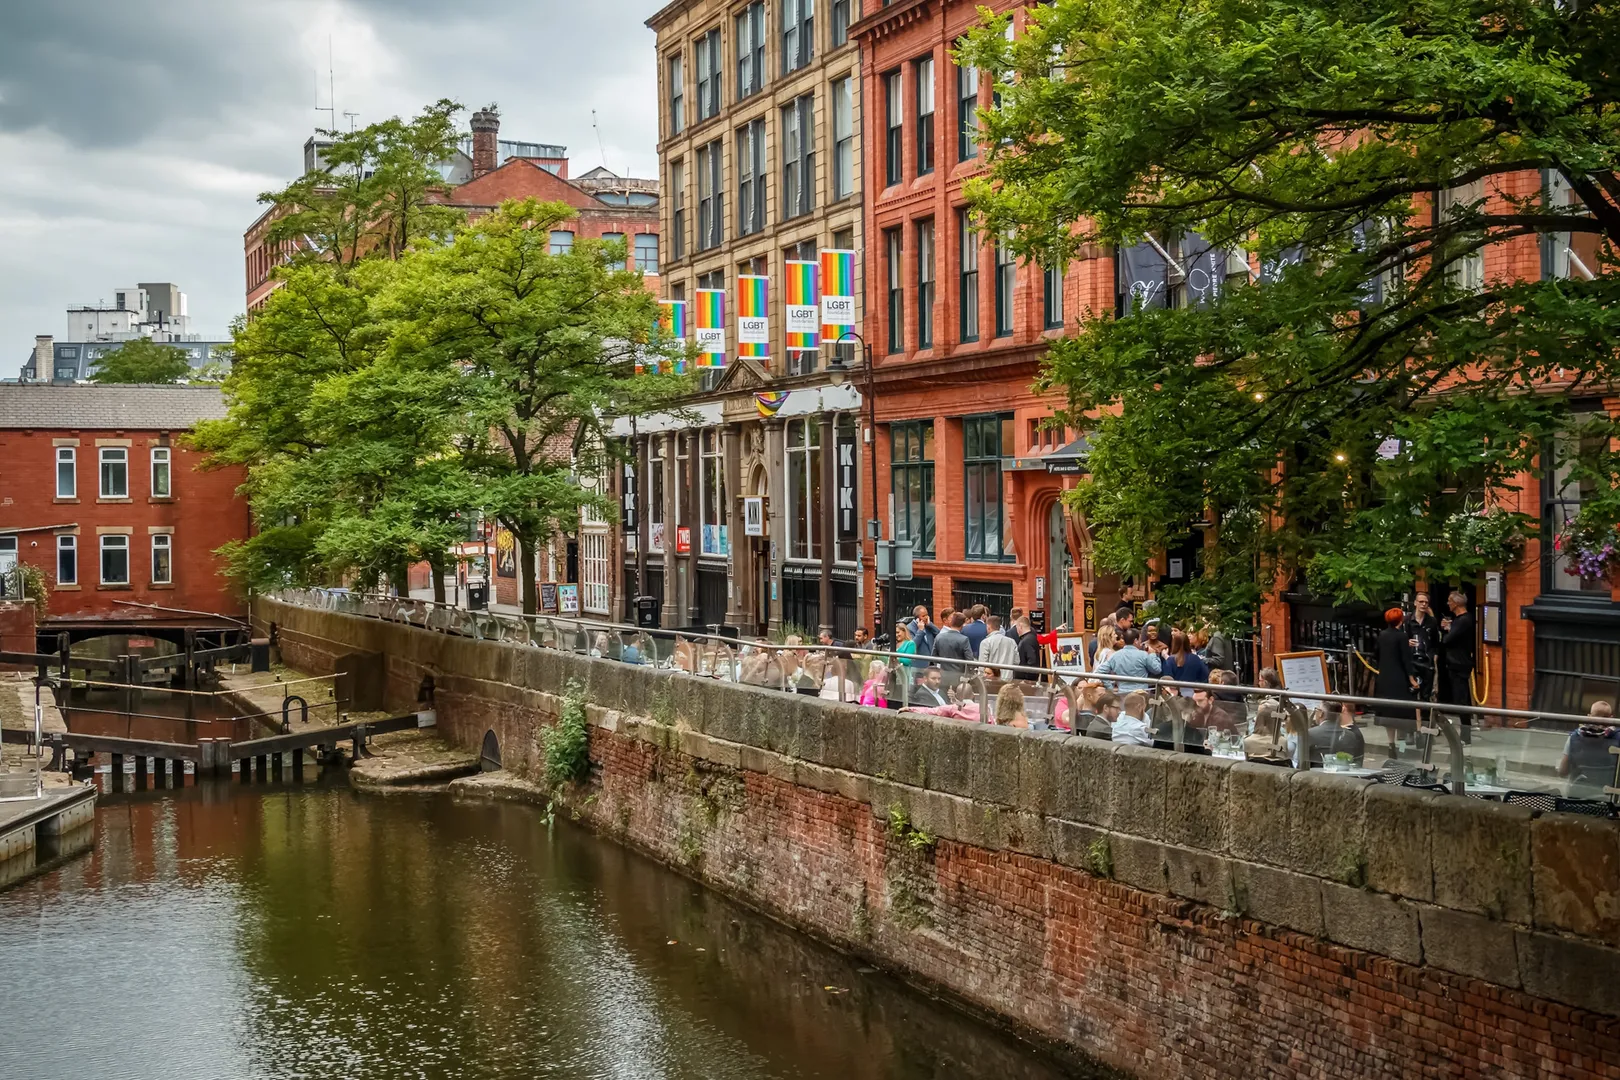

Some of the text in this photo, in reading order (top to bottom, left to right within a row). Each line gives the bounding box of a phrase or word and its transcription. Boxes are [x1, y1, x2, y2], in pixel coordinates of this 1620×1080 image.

[827, 300, 850, 309] LGBT
[791, 310, 814, 318] LGBT
[743, 321, 765, 329] LGBT
[700, 332, 721, 340] LGBT
[841, 444, 853, 531] KIKI
[625, 464, 635, 526] KIKI
[748, 501, 759, 525] KIKI
